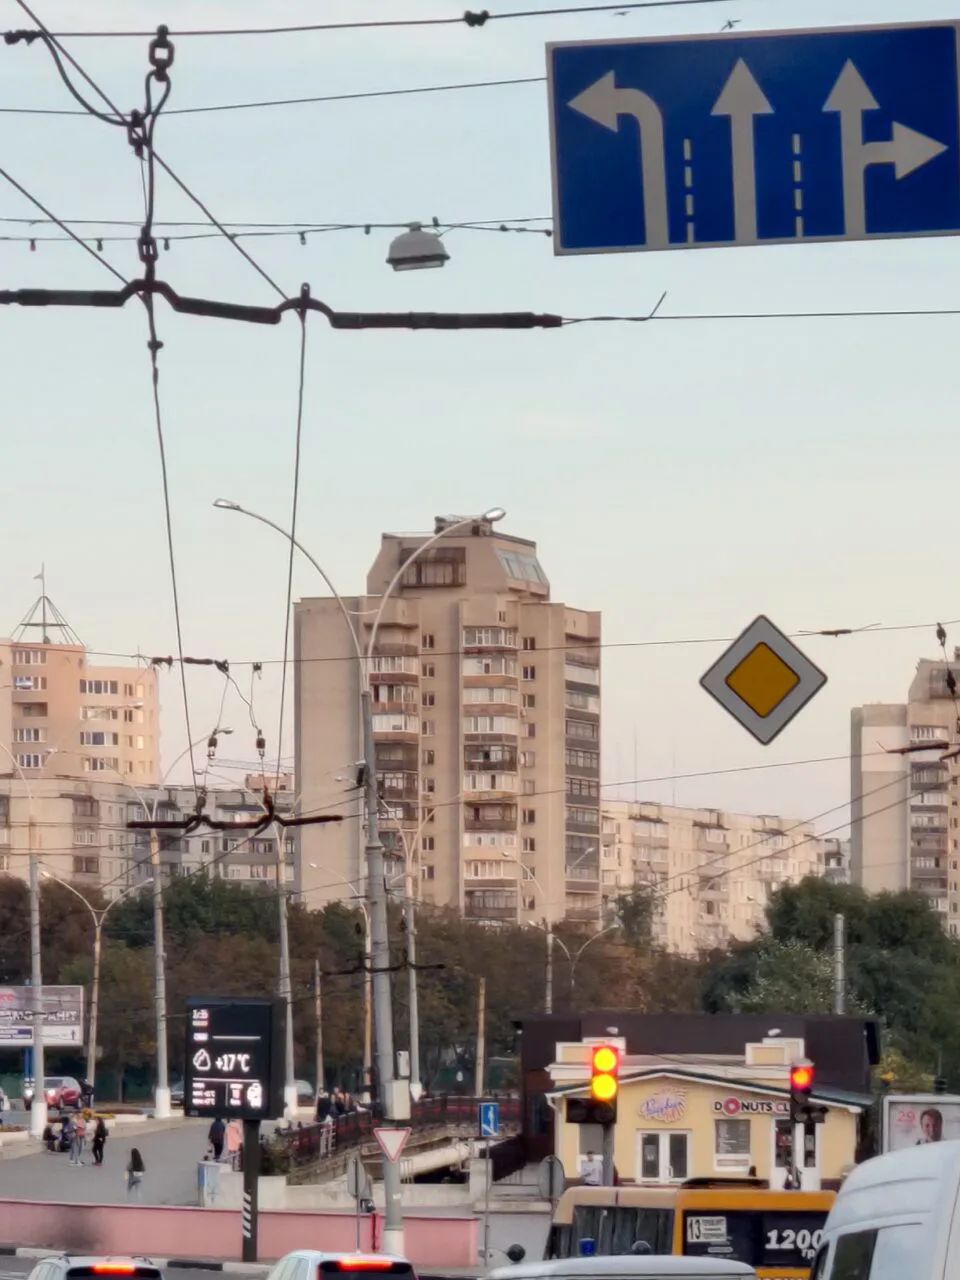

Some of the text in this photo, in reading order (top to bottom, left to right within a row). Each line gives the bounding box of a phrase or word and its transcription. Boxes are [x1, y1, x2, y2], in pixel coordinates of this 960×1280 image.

[775, 1101, 790, 1112] CL
[689, 1218, 701, 1240] 13
[801, 1249, 816, 1259] гр
